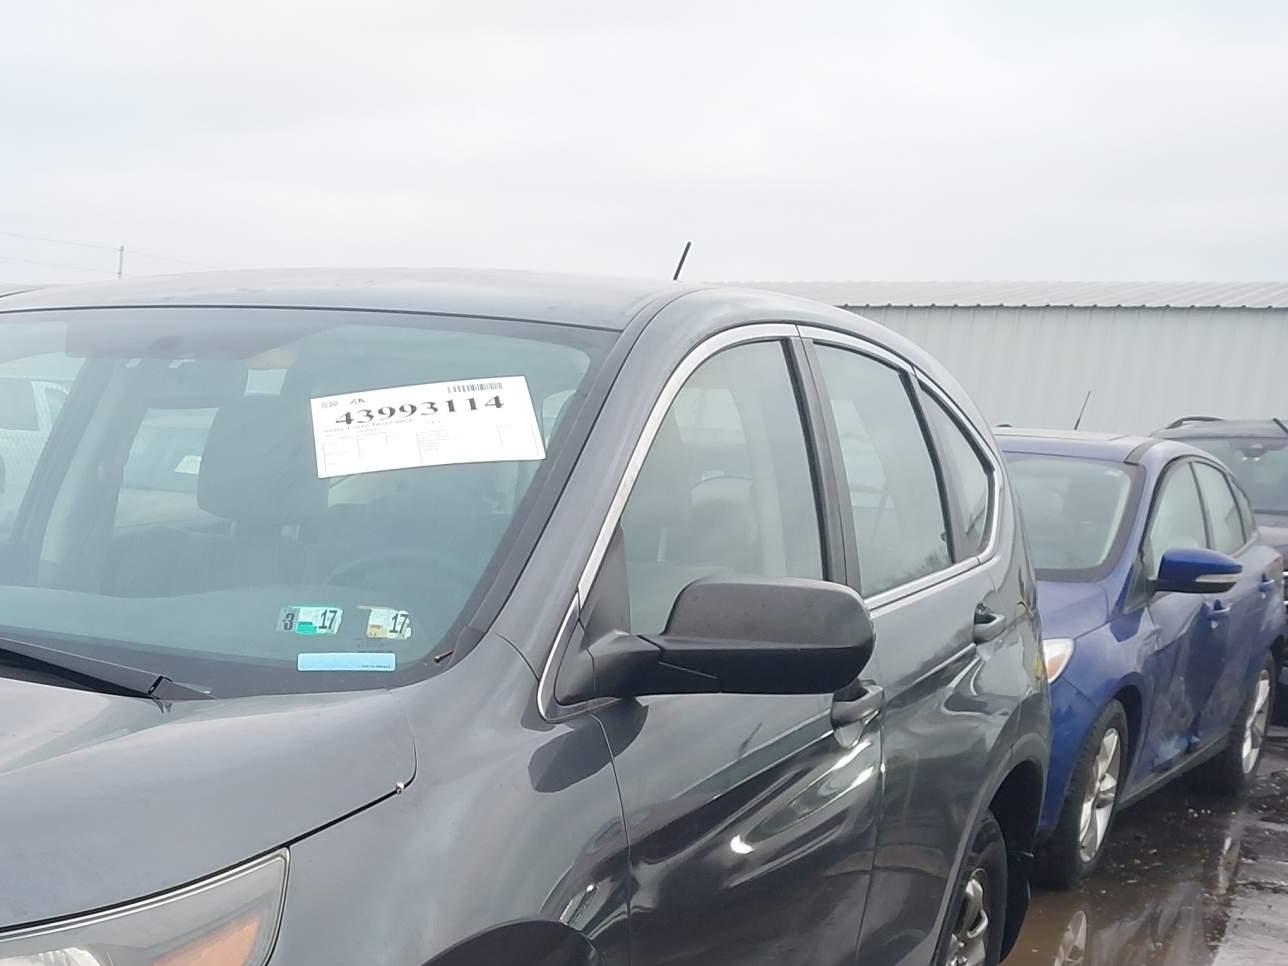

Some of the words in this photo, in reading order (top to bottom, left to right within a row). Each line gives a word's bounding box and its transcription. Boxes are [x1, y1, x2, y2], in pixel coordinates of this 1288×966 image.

[335, 395, 504, 425] 43993114
[318, 608, 338, 630] 17
[389, 612, 409, 634] 17
